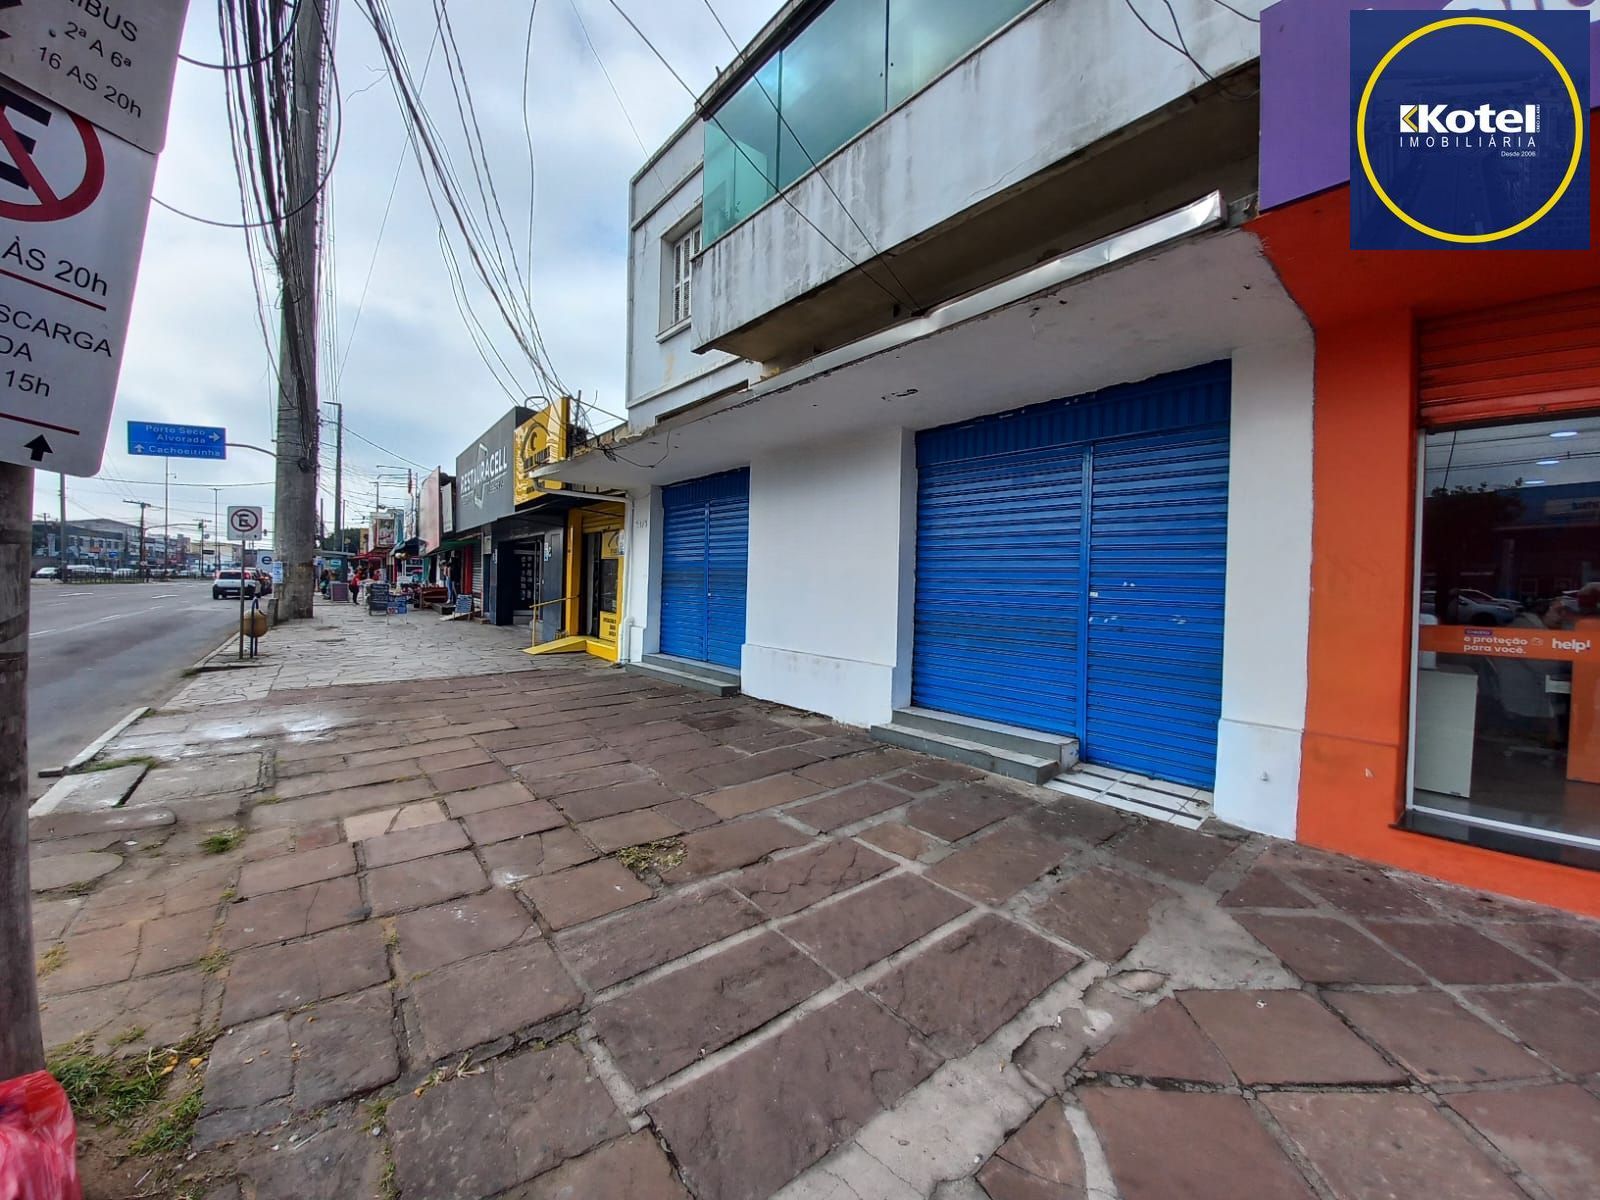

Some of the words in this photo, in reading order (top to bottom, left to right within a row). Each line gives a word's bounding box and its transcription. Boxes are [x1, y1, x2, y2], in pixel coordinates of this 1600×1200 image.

[69, 0, 138, 41] BUS
[89, 39, 104, 58] A
[39, 46, 63, 70] 16
[66, 65, 98, 91] AS
[103, 85, 142, 119] 20h
[1, 235, 46, 272] ÀS
[54, 259, 108, 297] 20h
[5, 369, 50, 397] 15h
[145, 424, 176, 434] Porto
[179, 426, 206, 436] Seco
[156, 433, 206, 444] Alvorada
[148, 445, 221, 457] Cachoeirinha
[1463, 644, 1492, 652] para
[1472, 635, 1529, 647] proteção
[1551, 637, 1592, 653] help!
